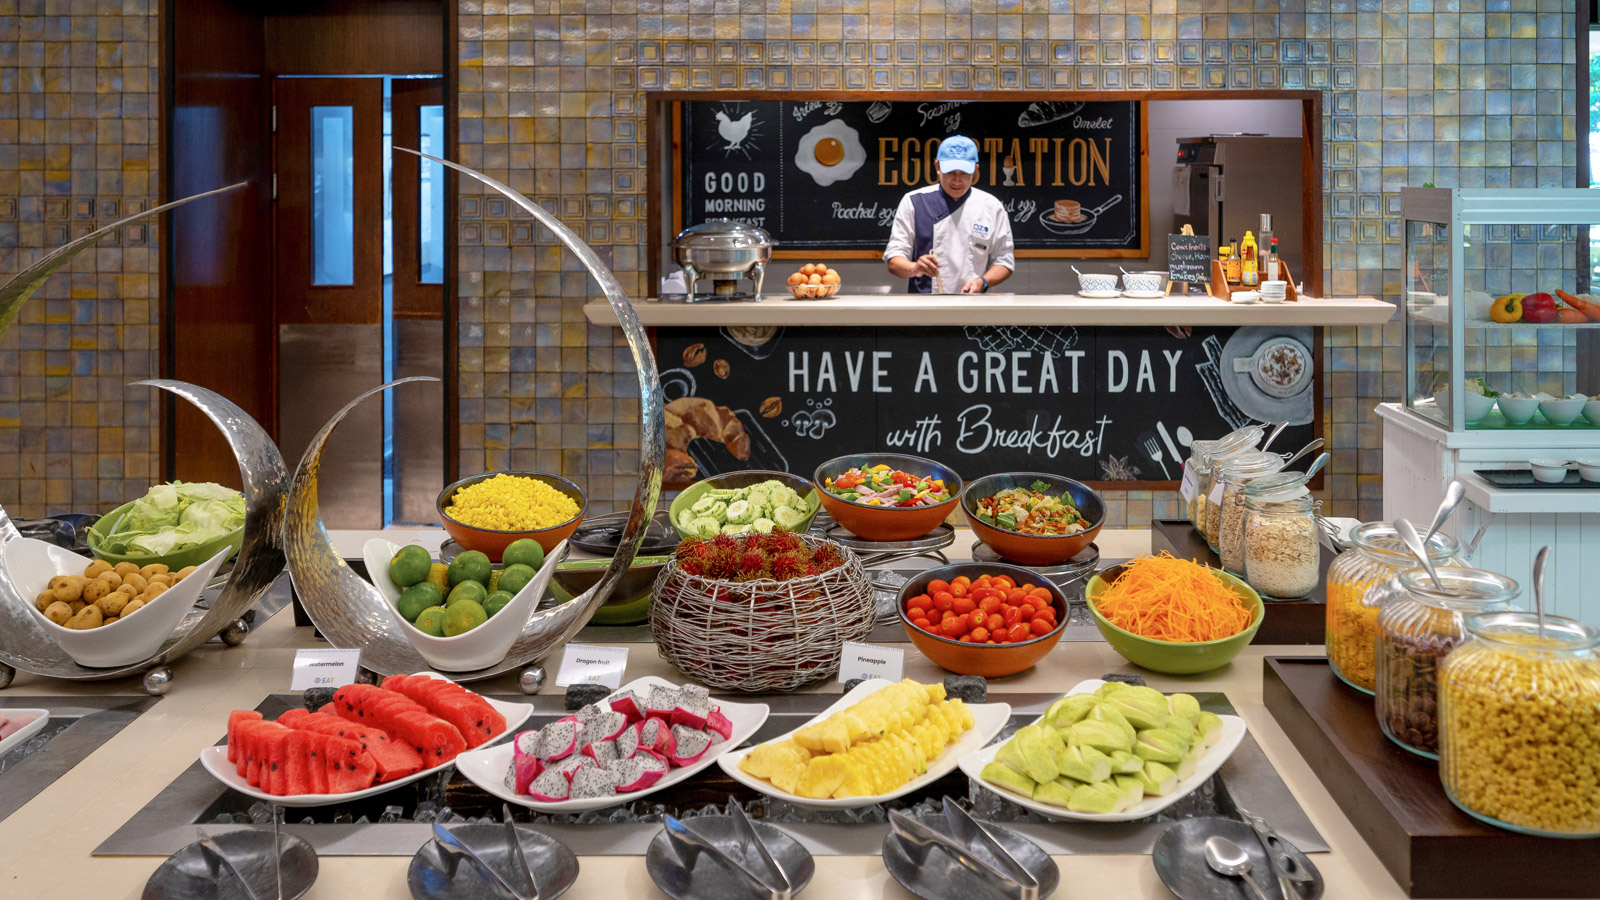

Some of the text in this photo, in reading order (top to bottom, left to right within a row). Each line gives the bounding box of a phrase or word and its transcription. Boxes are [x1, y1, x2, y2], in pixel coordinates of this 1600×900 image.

[1072, 115, 1113, 129] Omelet
[704, 171, 766, 193] GOOD
[705, 198, 766, 213] MORNING
[788, 350, 1183, 394] HAVE A GREAT DAY
[886, 404, 1112, 459] with Breakfast
[857, 656, 886, 665] Pineapple
